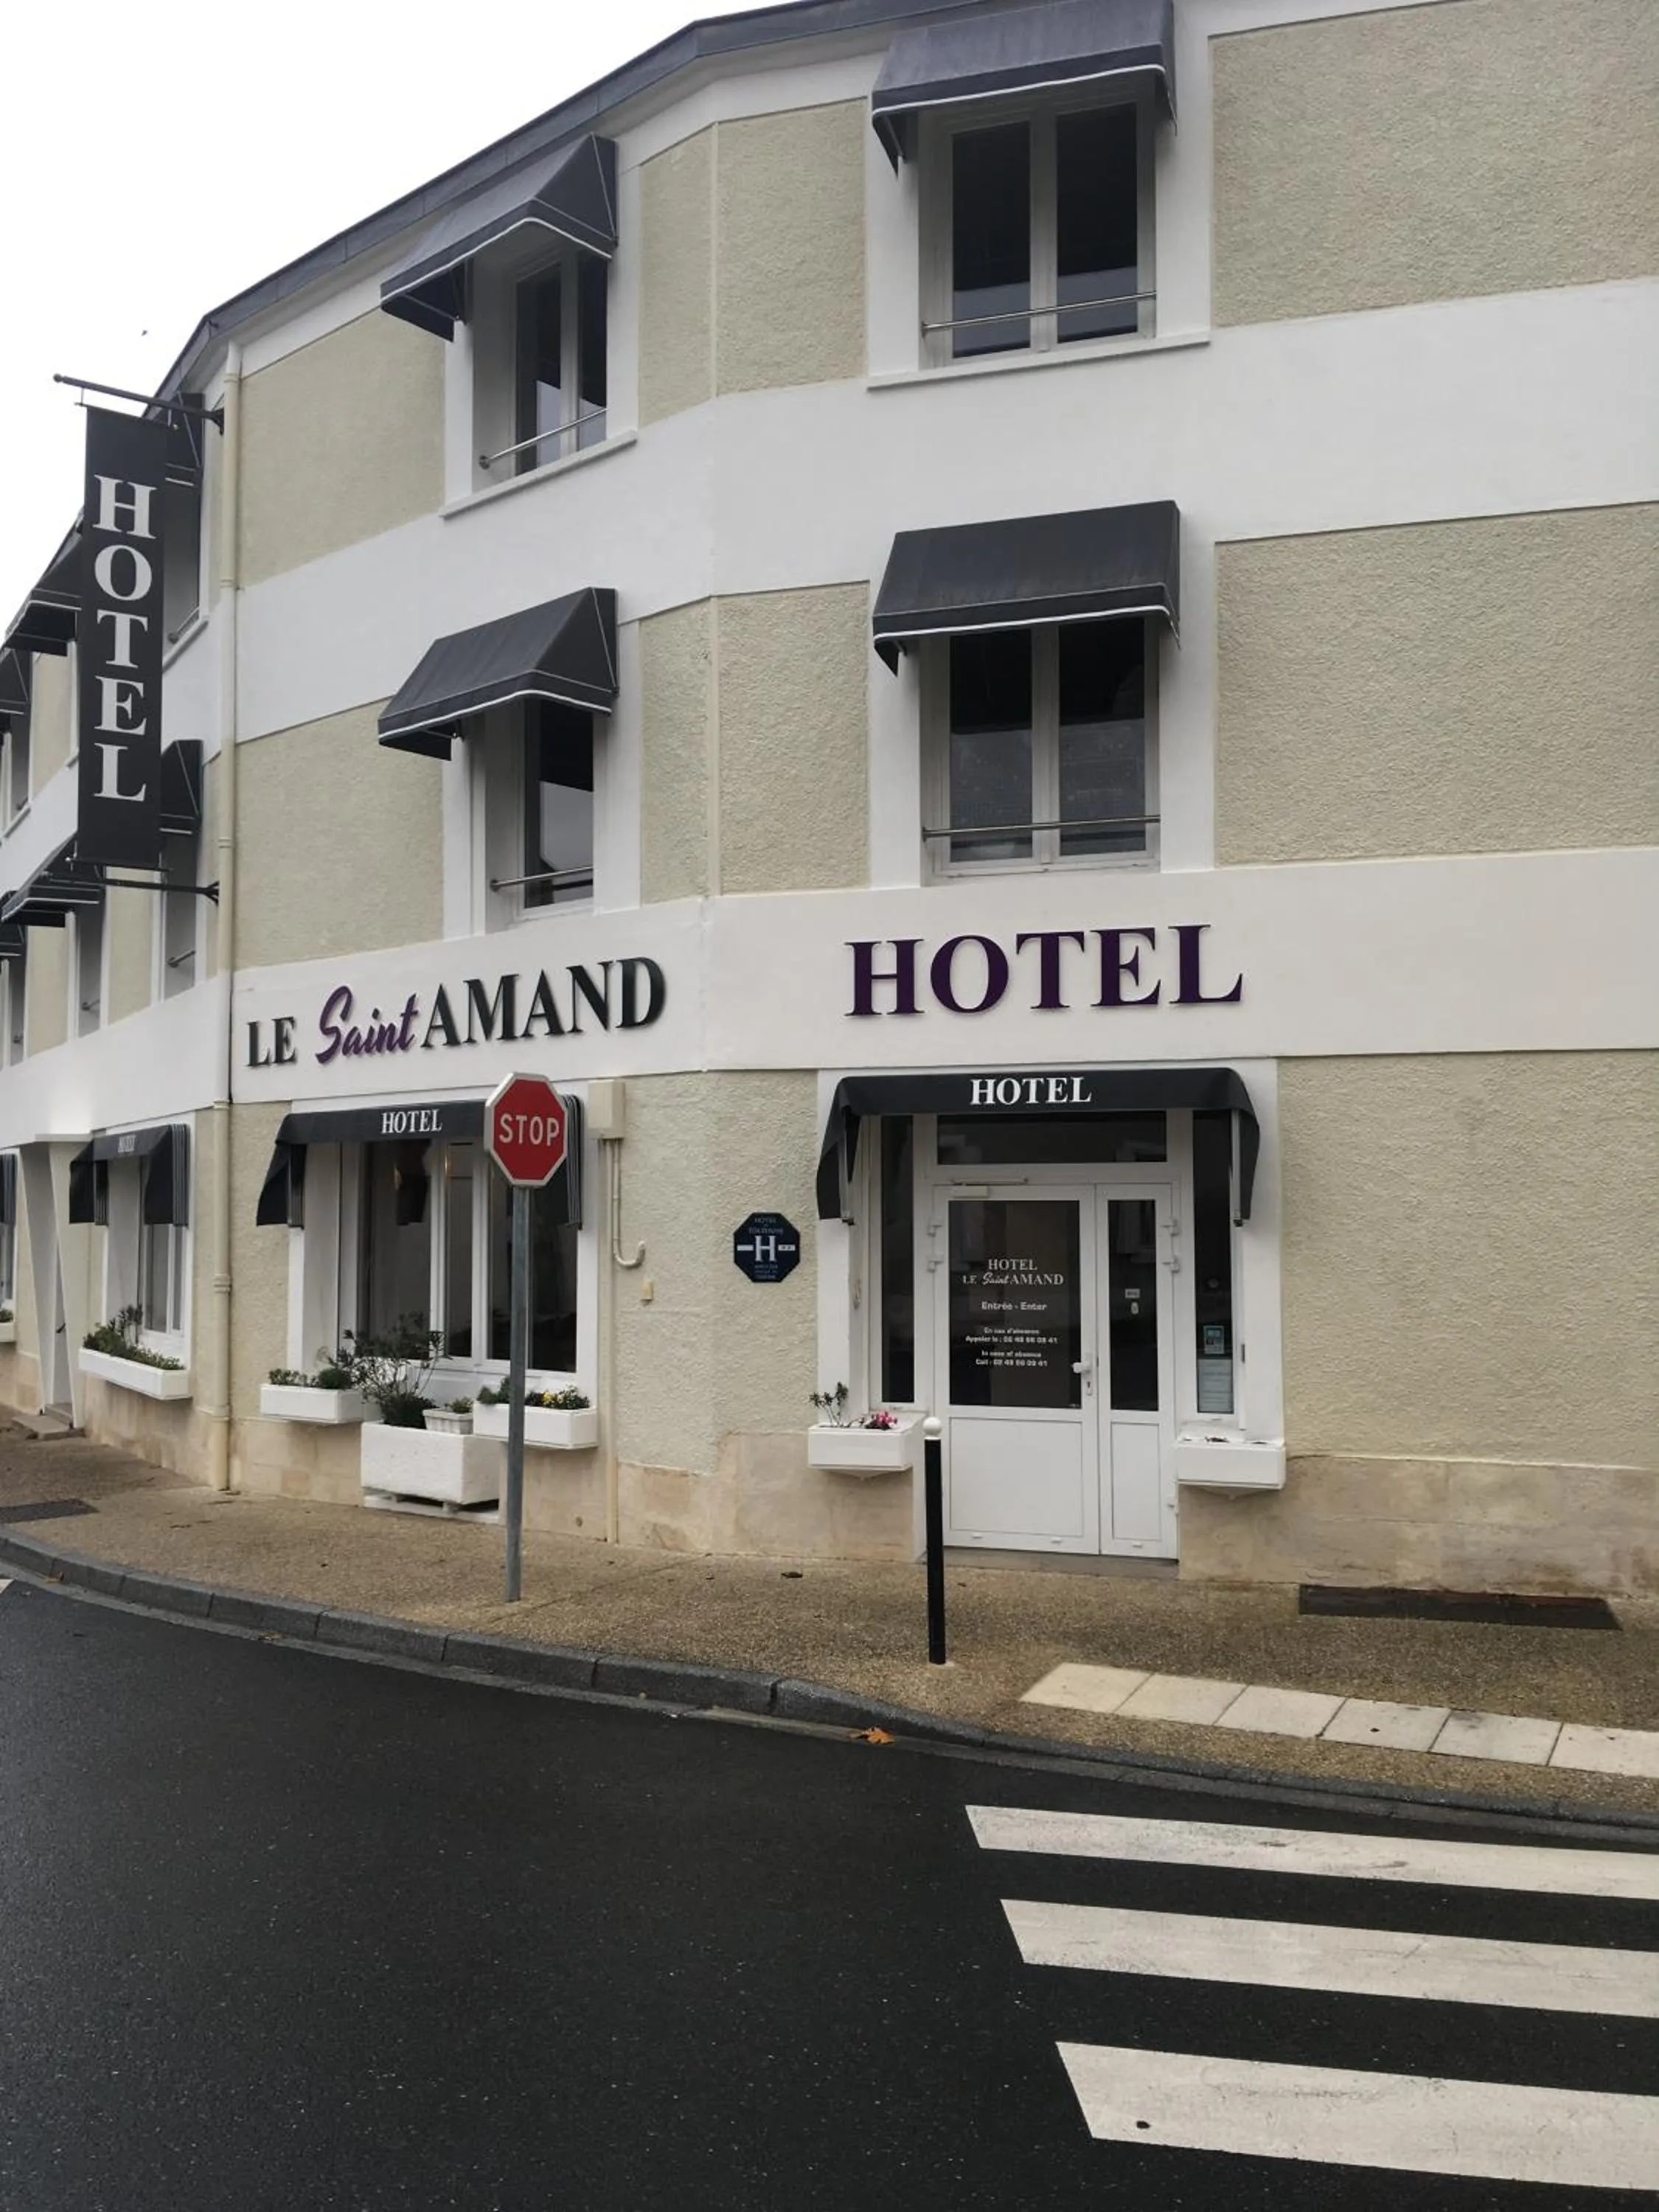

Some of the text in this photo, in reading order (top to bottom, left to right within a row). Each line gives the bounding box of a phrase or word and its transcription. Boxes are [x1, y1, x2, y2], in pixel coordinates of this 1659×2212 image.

[93, 474, 157, 802] HOTEL
[844, 924, 1243, 1017] HOTEL
[247, 956, 666, 1068] LE Saint AMAND
[970, 1077, 1092, 1105] HOTEL
[380, 1108, 443, 1135] HOTEL
[498, 1113, 560, 1147] STOP
[754, 1235, 776, 1262] H
[988, 1258, 1038, 1271] HOTEL
[962, 1271, 1065, 1286] LE Saint AMAND
[1020, 1301, 1048, 1311] Enter
